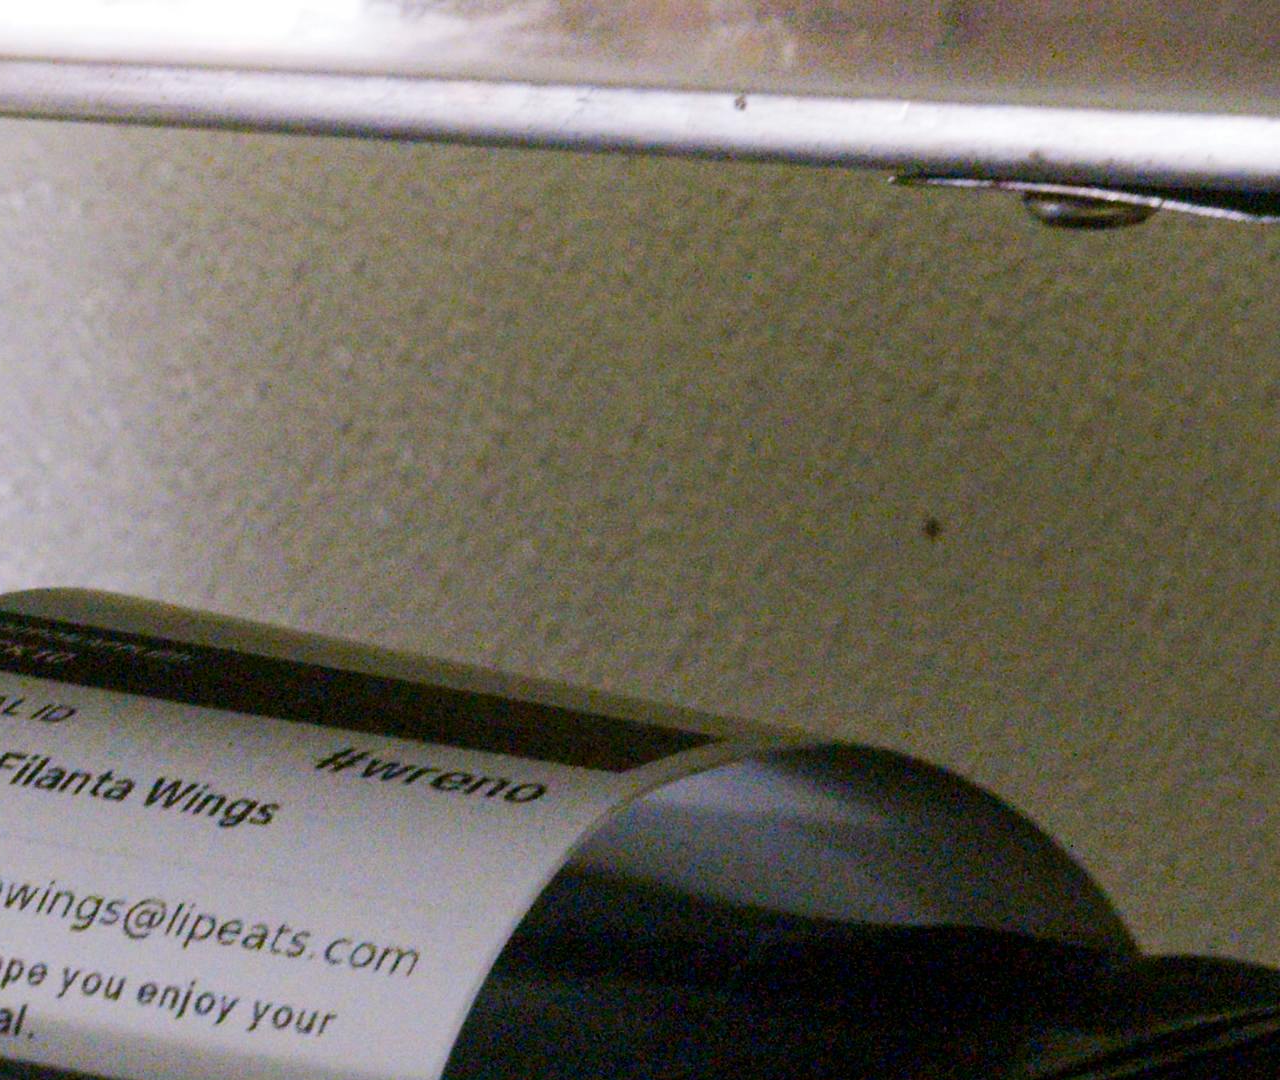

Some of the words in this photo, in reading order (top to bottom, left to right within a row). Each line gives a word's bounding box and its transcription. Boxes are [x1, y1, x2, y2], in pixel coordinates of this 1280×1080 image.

[30, 702, 78, 723] ID
[142, 775, 280, 828] Wings
[314, 747, 547, 803] #wreno
[56, 966, 126, 1001] you
[137, 978, 239, 1026] enjoy
[246, 1000, 337, 1037] your
